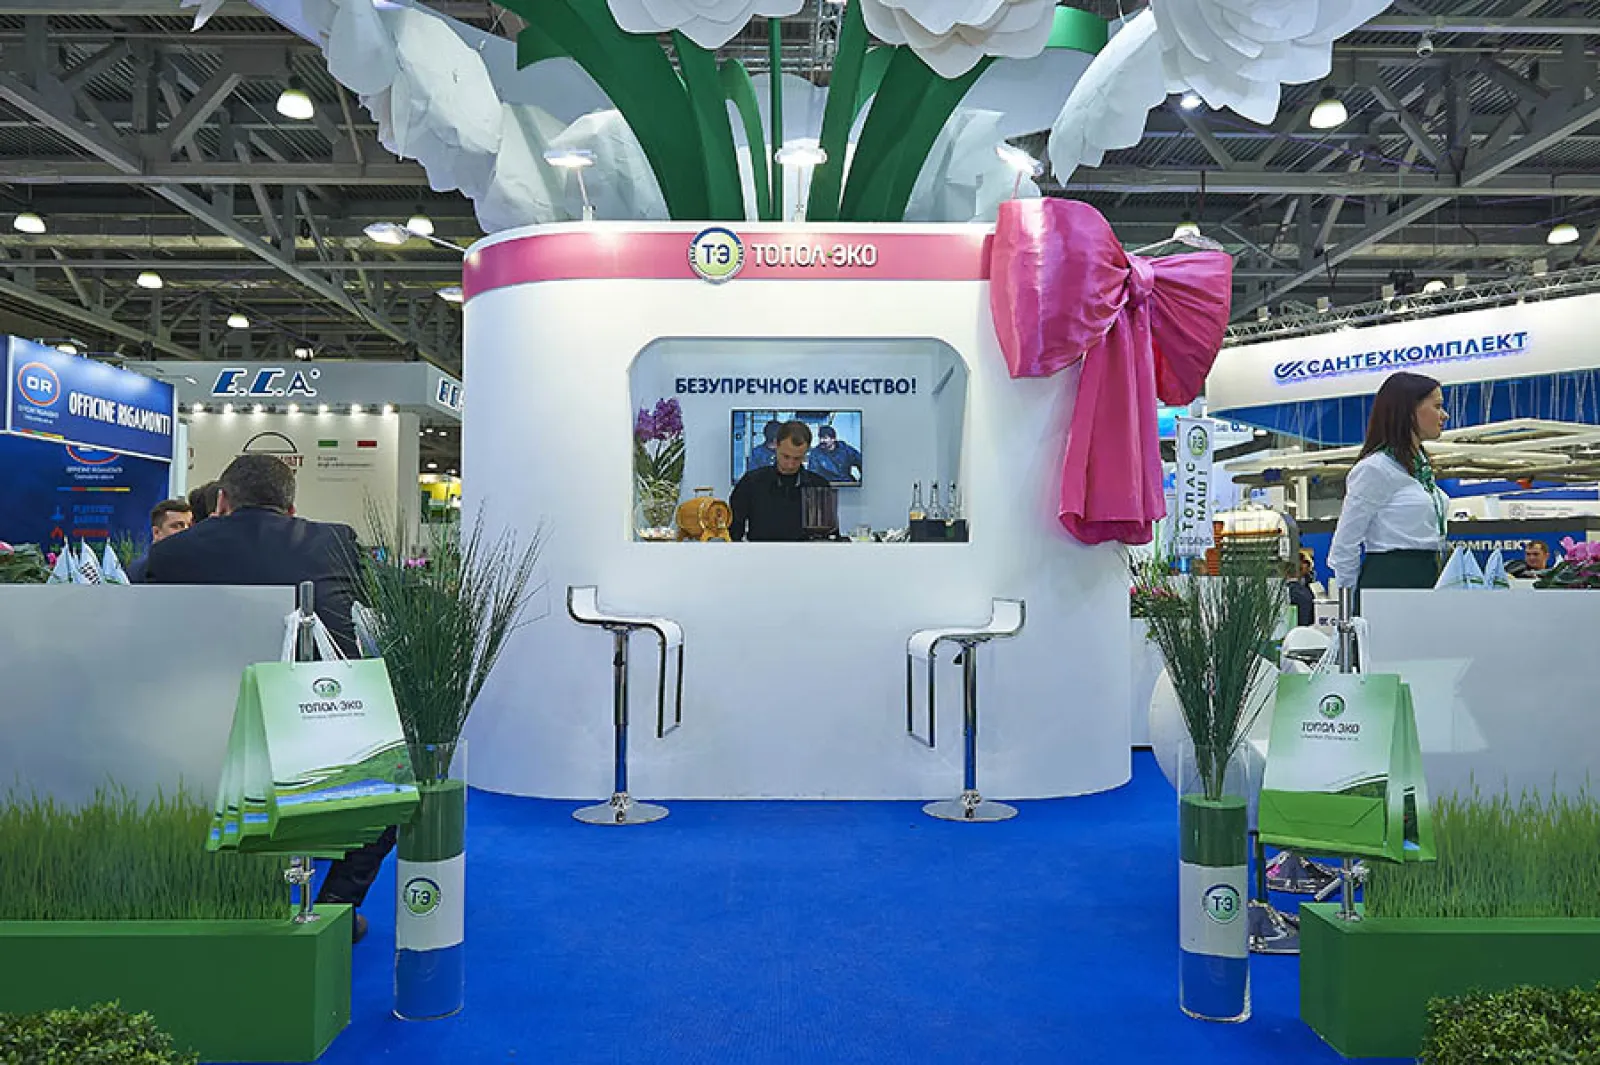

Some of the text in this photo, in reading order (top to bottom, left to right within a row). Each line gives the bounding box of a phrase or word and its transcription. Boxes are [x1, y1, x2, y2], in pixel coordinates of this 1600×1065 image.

[1306, 331, 1528, 373] САНТЕХКОМПЛЕКТ
[26, 376, 53, 393] OR
[675, 377, 917, 395] БЕЗУПРЕЧНОЕ КАЧЕСТВО!
[69, 392, 117, 423] OFFICINE
[117, 401, 171, 436] RIGAMONTI
[1182, 462, 1196, 532] ТОПАС
